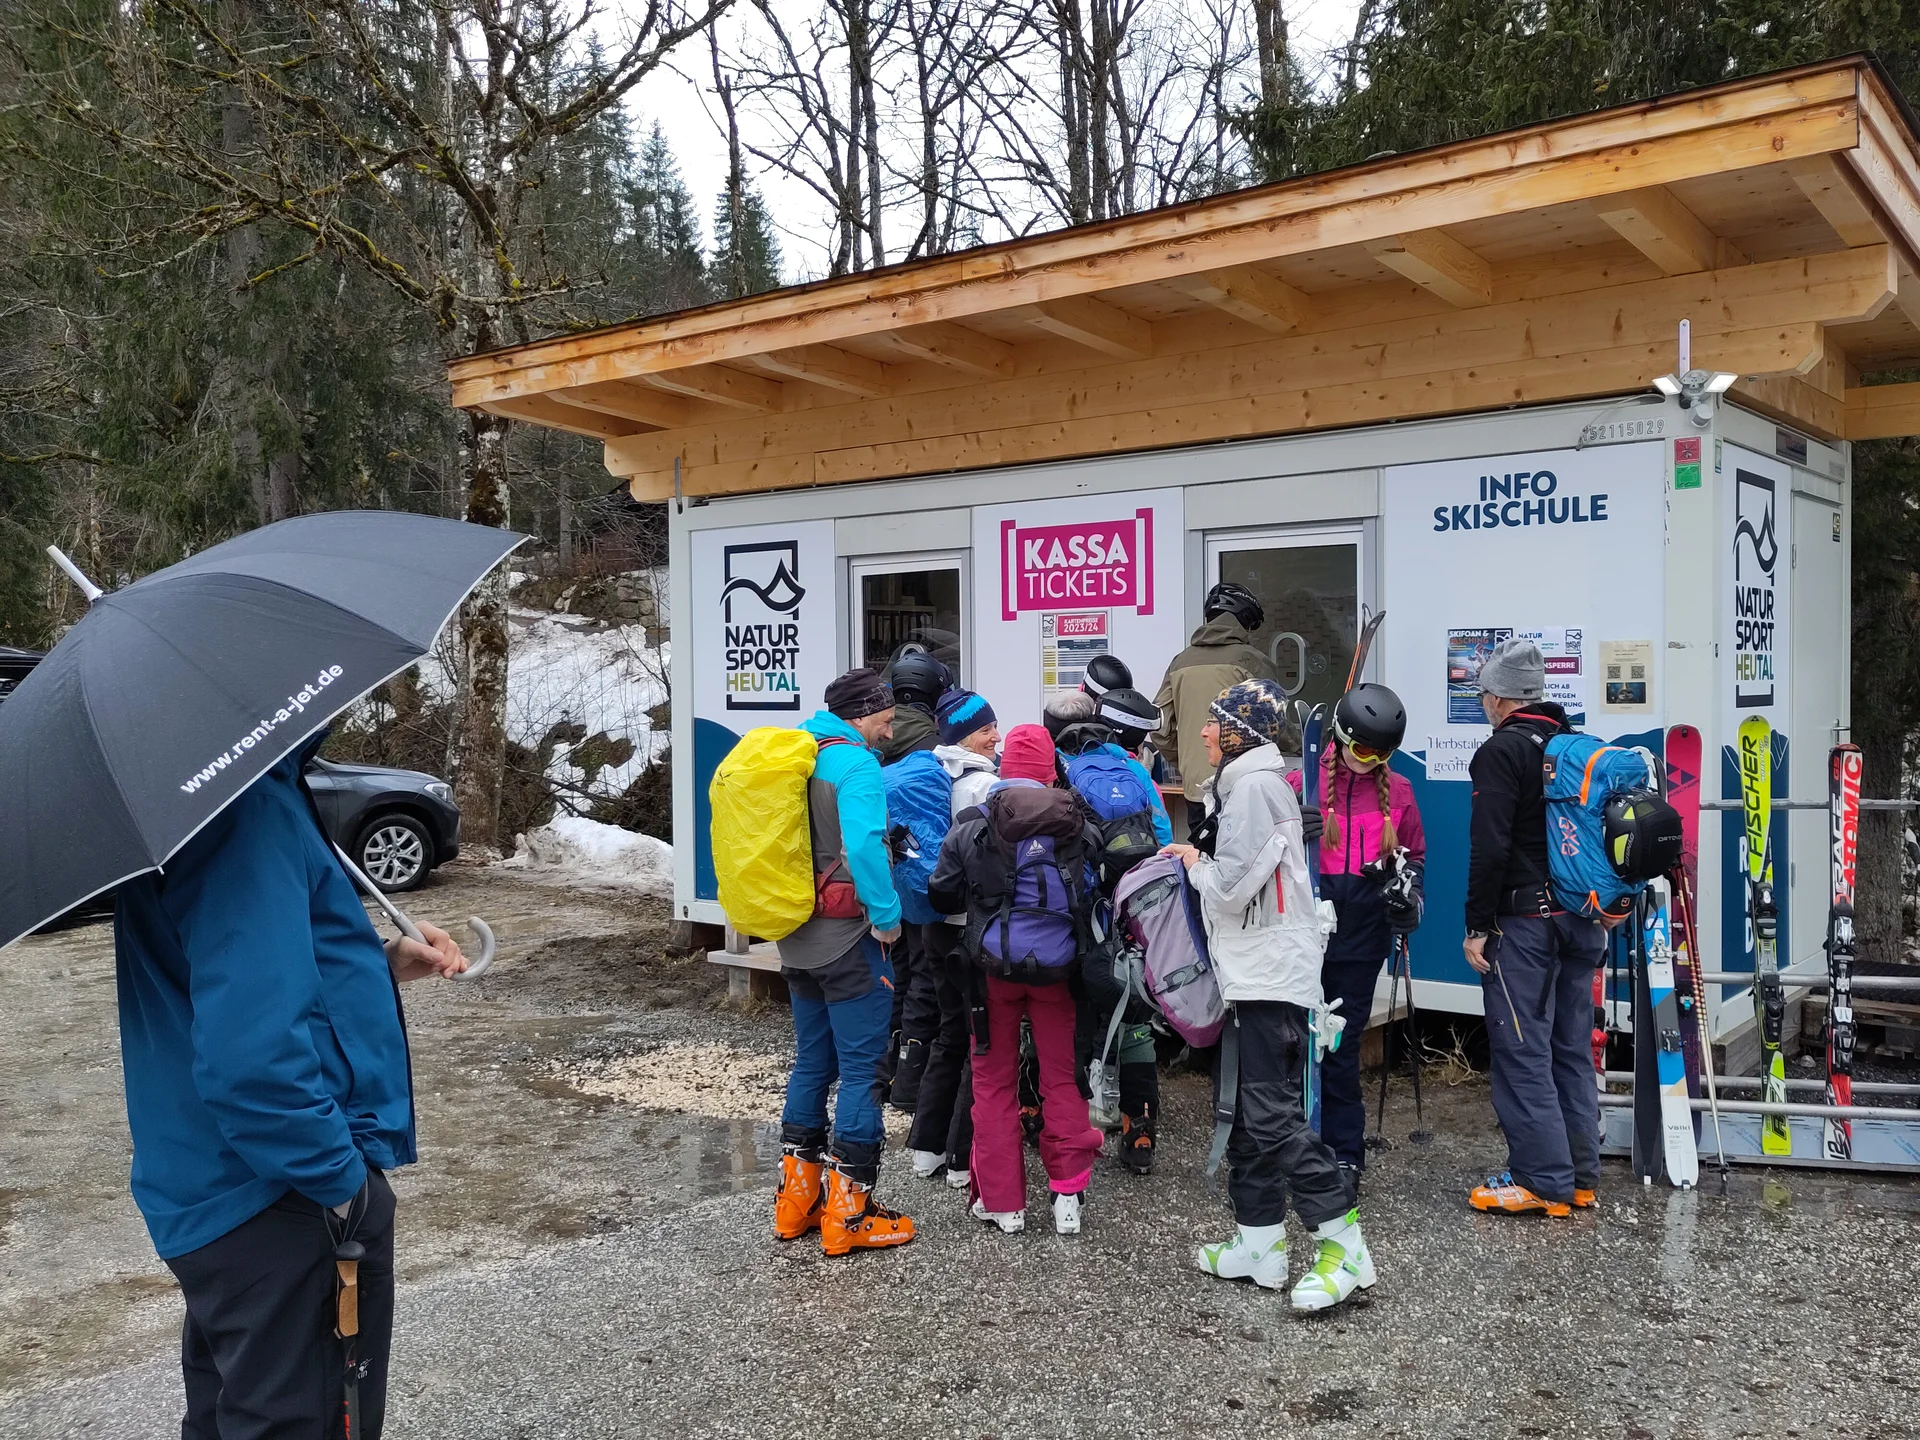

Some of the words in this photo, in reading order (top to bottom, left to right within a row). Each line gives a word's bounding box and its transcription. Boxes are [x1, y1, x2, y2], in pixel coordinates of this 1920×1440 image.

[1480, 470, 1558, 501] INFO
[1433, 494, 1609, 532] SKISCHULE
[1024, 532, 1130, 570] KASSA
[1024, 567, 1127, 599] TICKETS
[1735, 585, 1775, 620] NATUR
[725, 623, 799, 648] NATUR
[1063, 622, 1099, 633] 2023/24
[1735, 619, 1775, 652] SPORT
[725, 648, 800, 671] SPORT
[1544, 661, 1576, 669] NSPERRE
[1735, 653, 1775, 681] HEUTAL
[726, 672, 801, 692] HEUTAL
[180, 664, 344, 794] www.rent-a-jet.de
[1742, 735, 1763, 858] FISCHER
[1832, 792, 1843, 882] RACE
[1843, 754, 1862, 889] ATOMIC
[1658, 834, 1682, 842] ORTOVO
[868, 1231, 909, 1243] SCARPA
